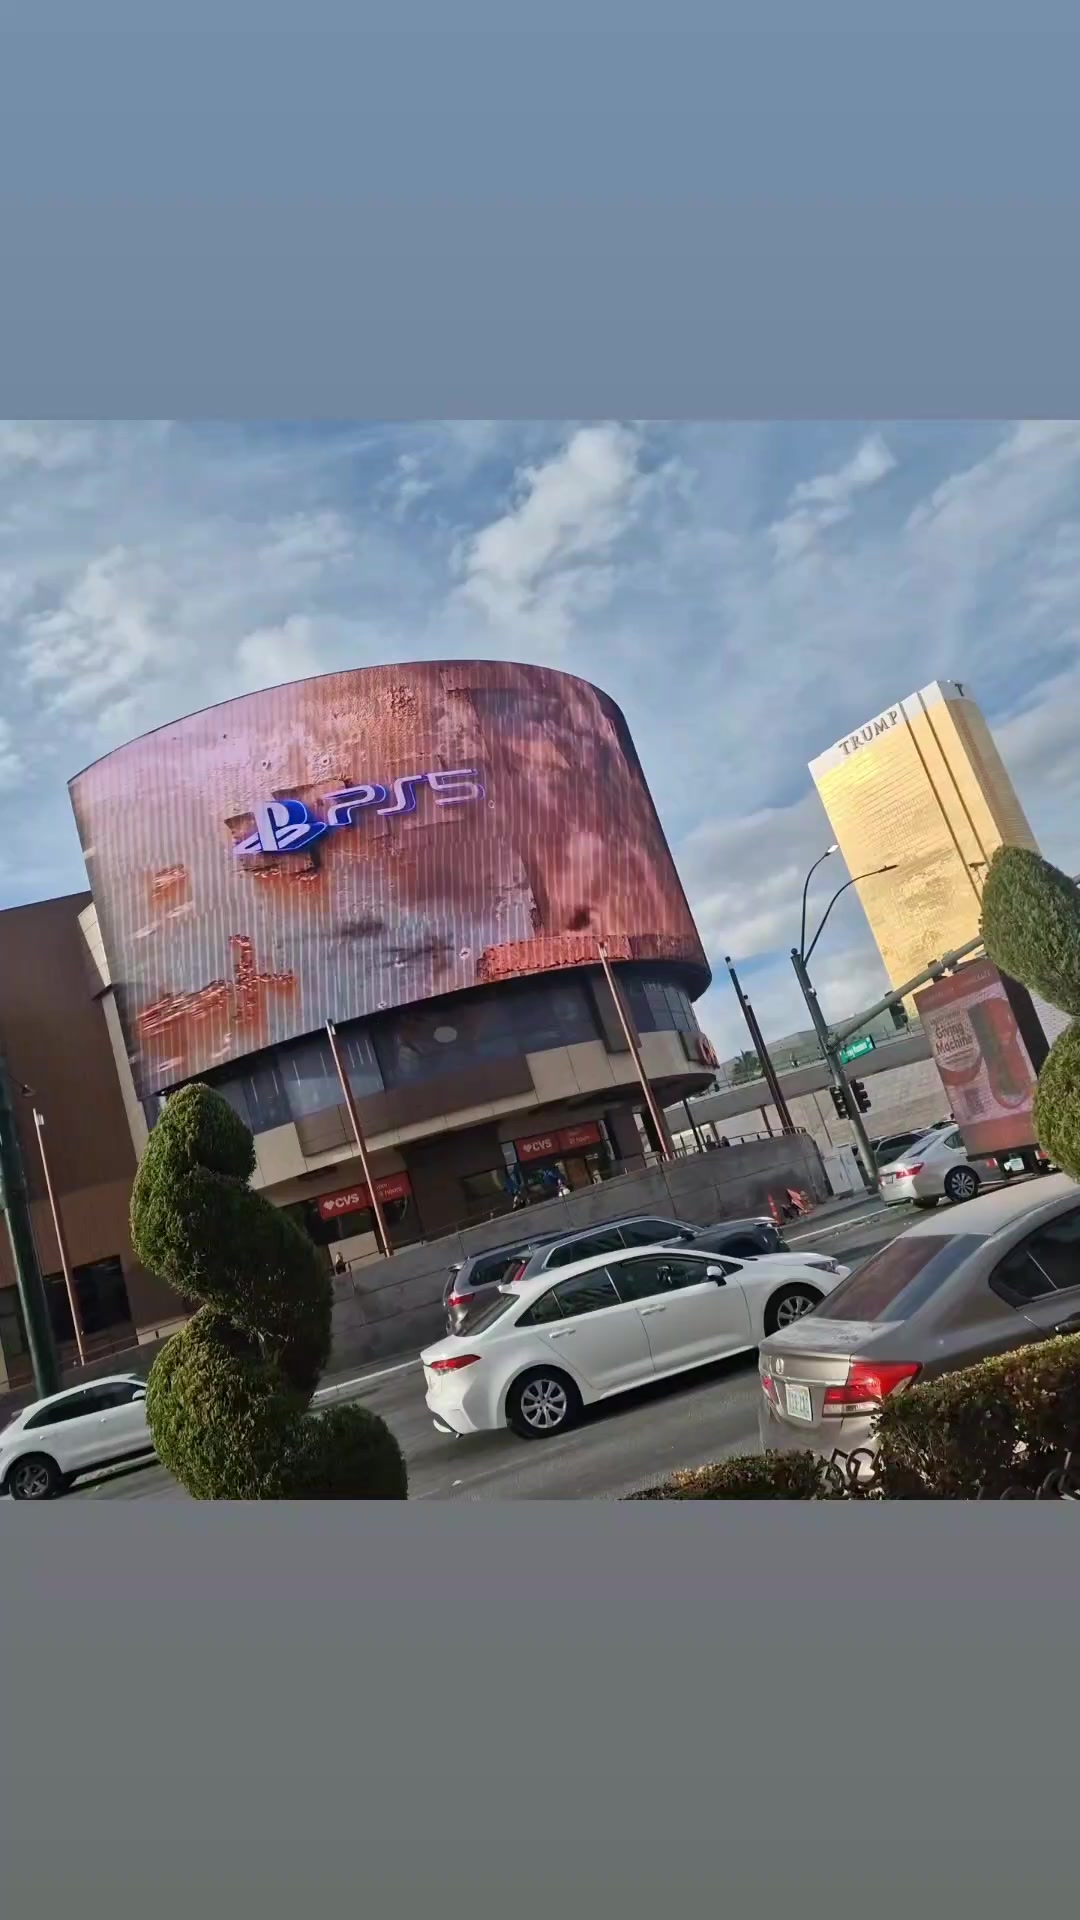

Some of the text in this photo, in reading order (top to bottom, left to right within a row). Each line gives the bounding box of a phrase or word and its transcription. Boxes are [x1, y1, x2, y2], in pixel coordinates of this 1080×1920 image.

[838, 710, 898, 756] TRUMP
[322, 768, 486, 826] PS5
[532, 1139, 552, 1151] CVS
[335, 1193, 360, 1209] CVS
